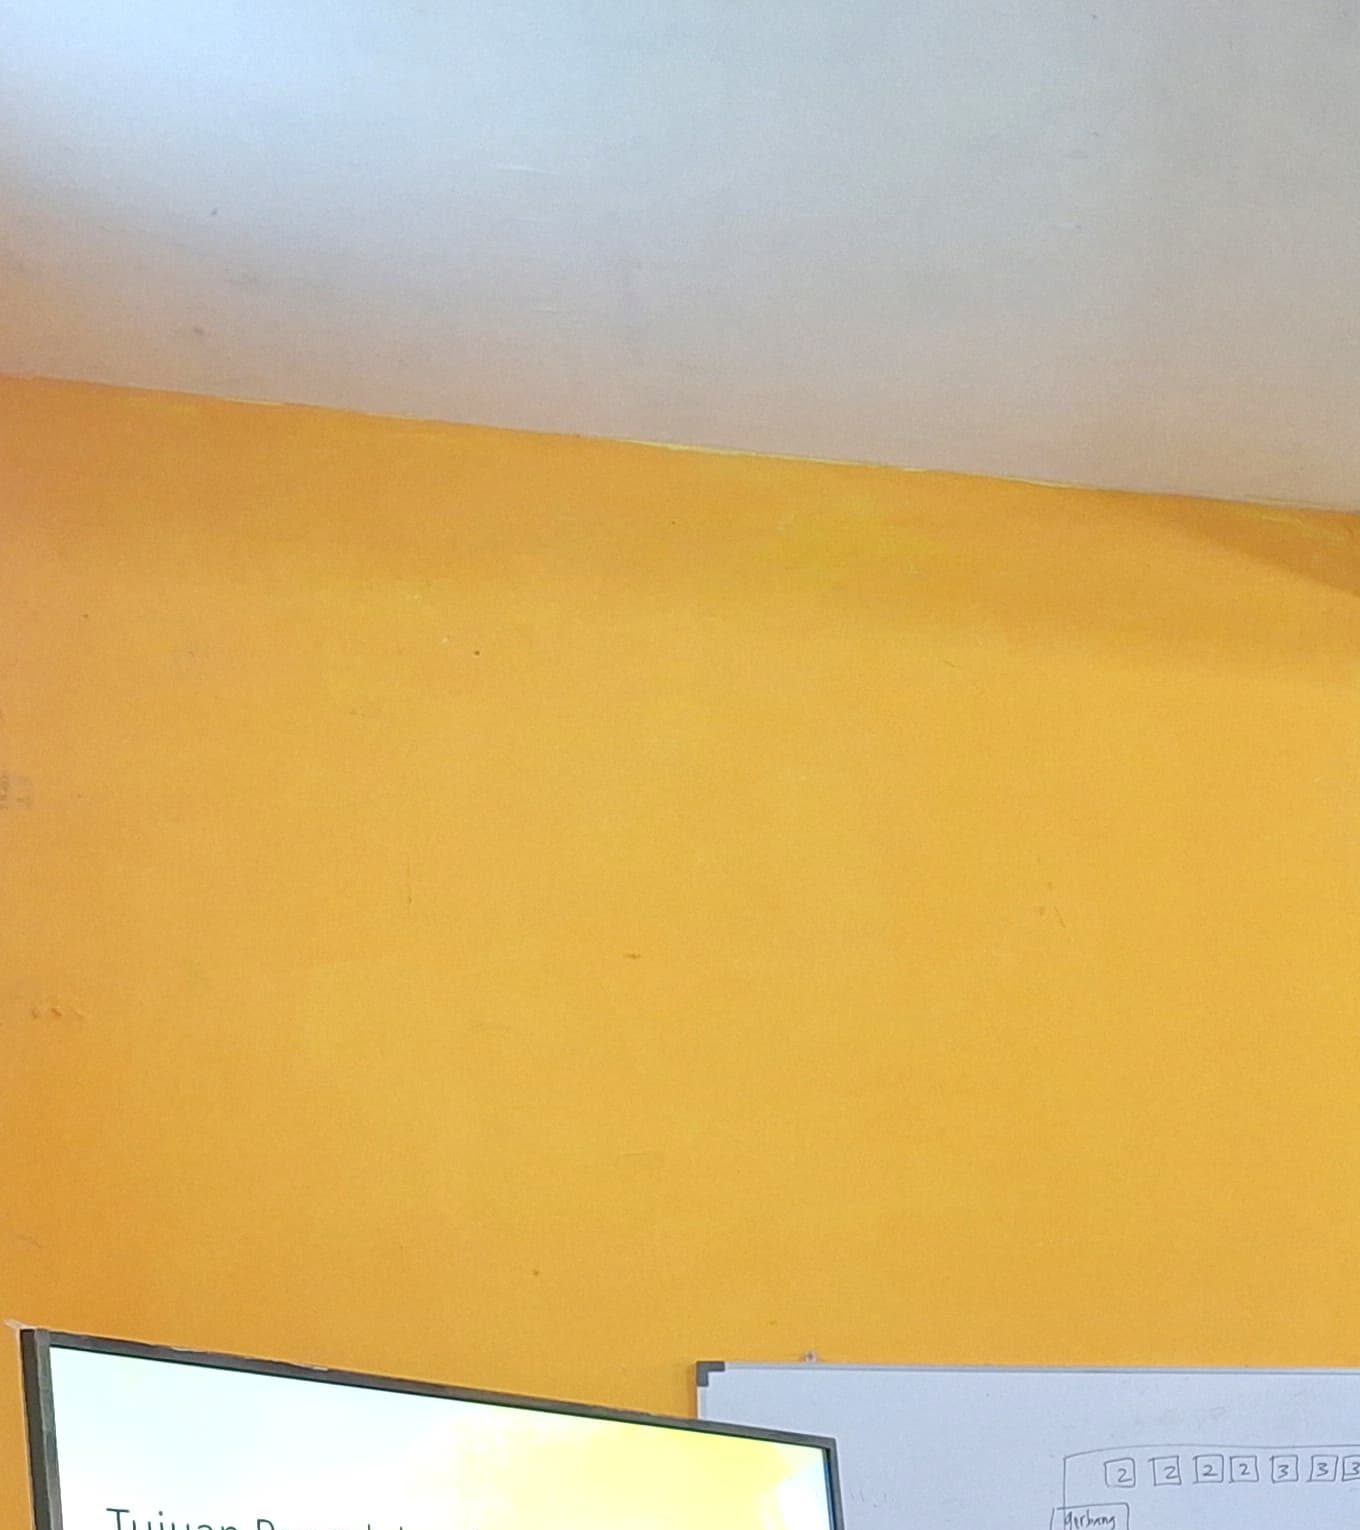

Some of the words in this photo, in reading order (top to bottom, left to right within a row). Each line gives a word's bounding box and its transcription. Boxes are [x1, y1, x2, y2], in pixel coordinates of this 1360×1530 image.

[1117, 1467, 1133, 1484] 2
[1163, 1465, 1179, 1480] 2
[1202, 1464, 1218, 1477] 2
[1238, 1463, 1251, 1476] 2
[1277, 1464, 1289, 1479] 3
[1316, 1462, 1329, 1477] 3
[1350, 1461, 1360, 1476] 3
